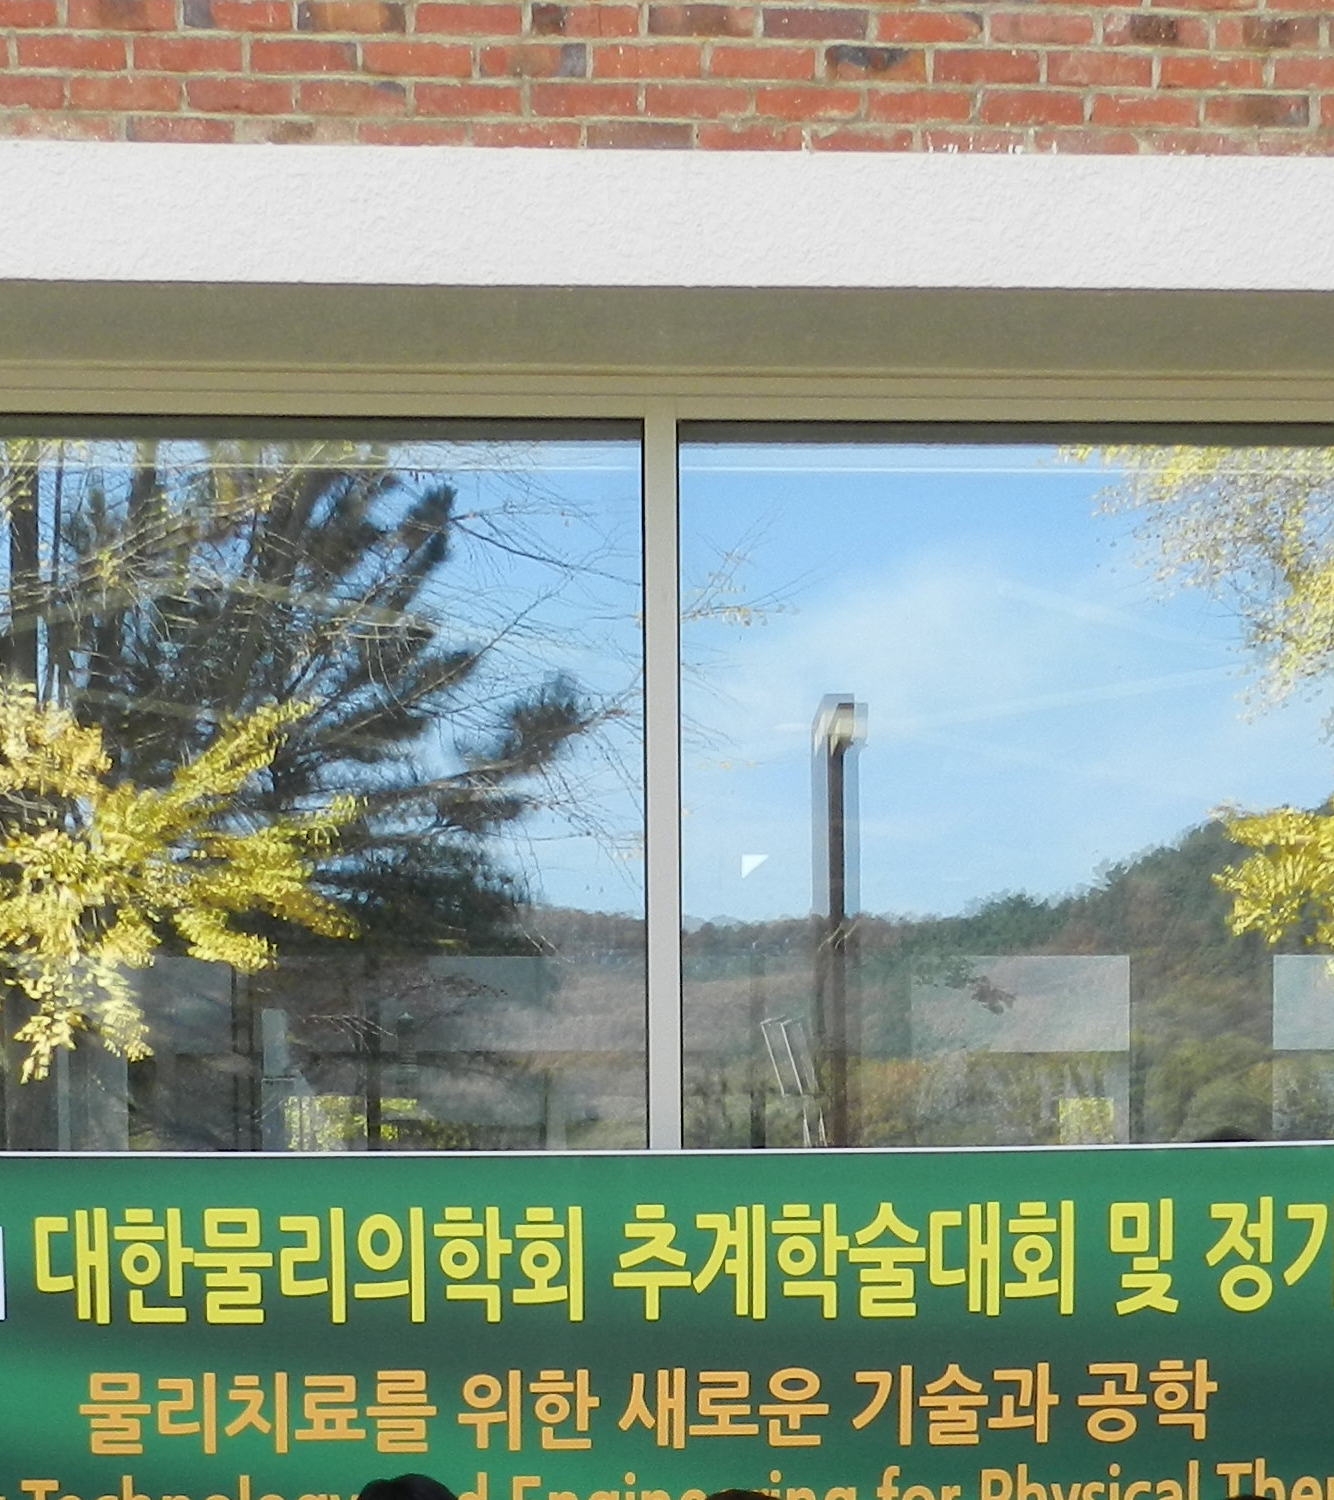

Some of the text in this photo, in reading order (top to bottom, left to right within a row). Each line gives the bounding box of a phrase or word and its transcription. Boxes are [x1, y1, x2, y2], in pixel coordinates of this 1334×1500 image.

[34, 1206, 583, 1324] 대한물리의학회
[612, 1199, 1075, 1320] 추계학술대회
[1110, 1198, 1179, 1315] 및
[79, 1359, 1218, 1455] 물리치료를 위한 새로운 기술과 공학
